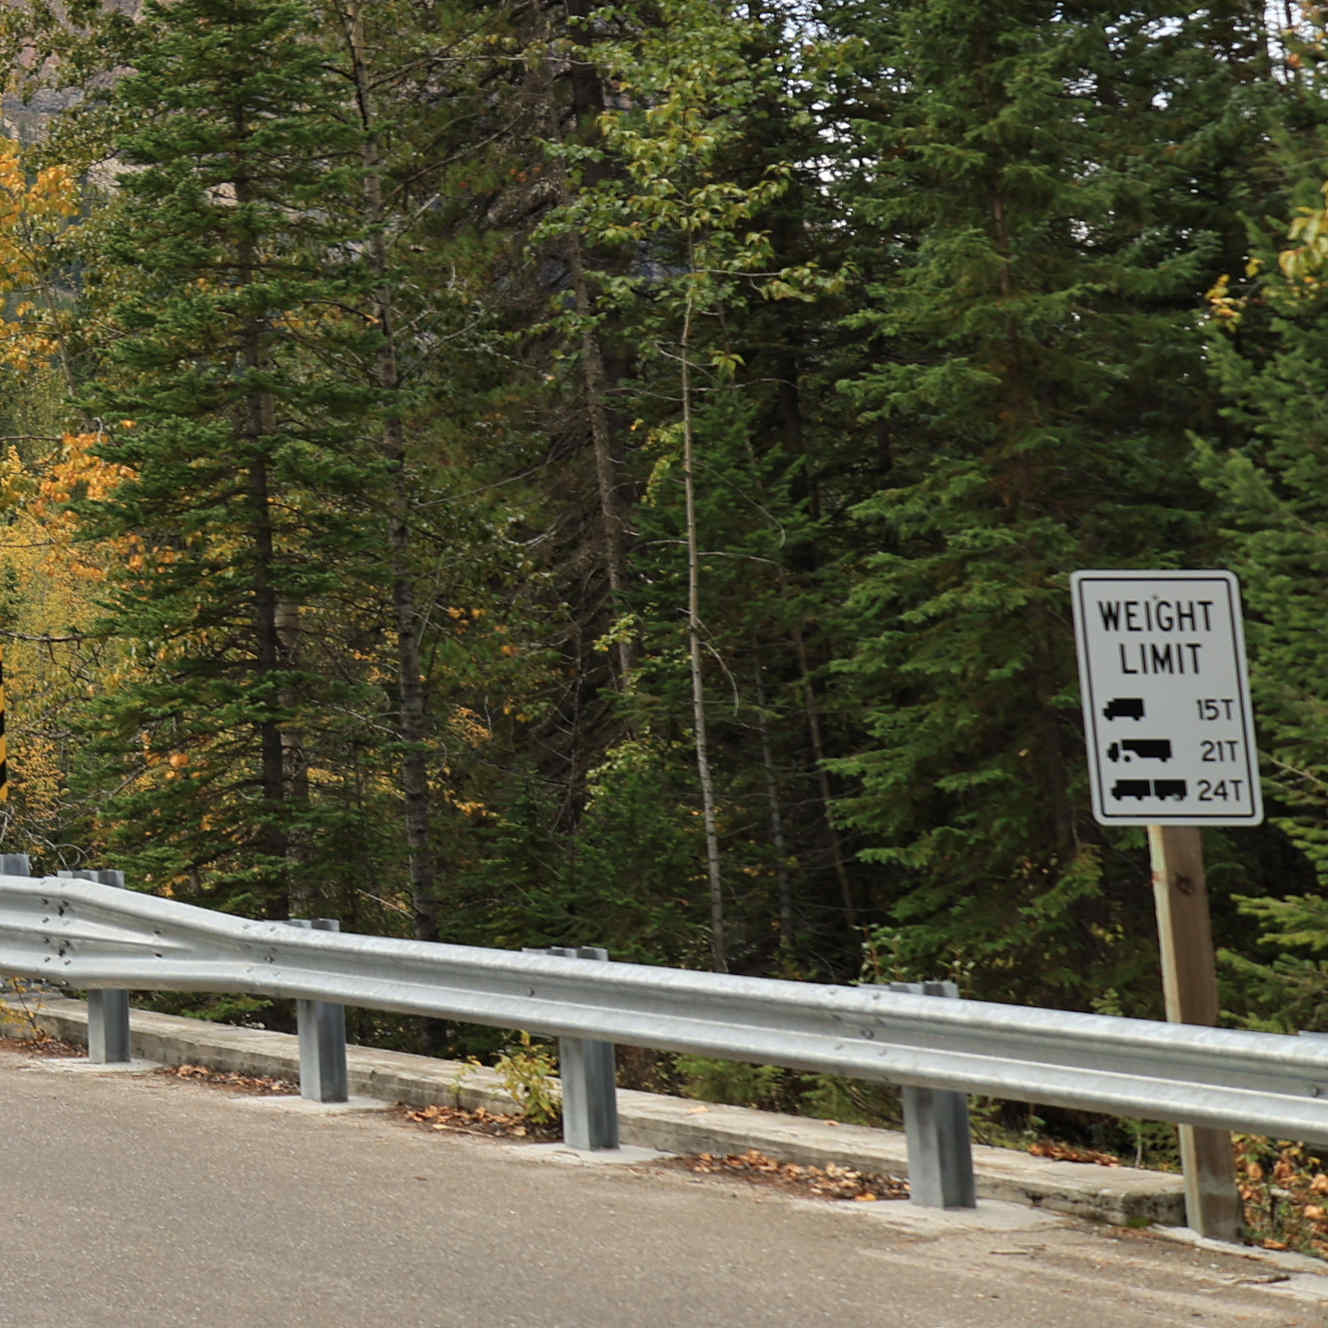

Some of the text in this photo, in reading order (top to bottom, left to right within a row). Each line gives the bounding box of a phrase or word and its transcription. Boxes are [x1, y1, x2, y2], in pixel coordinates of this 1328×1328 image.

[1098, 599, 1213, 632] WEIGHT
[1120, 643, 1202, 674] LIMIT
[1197, 699, 1233, 720] 15T
[1200, 740, 1238, 762] 21T
[1197, 779, 1243, 801] 24T
